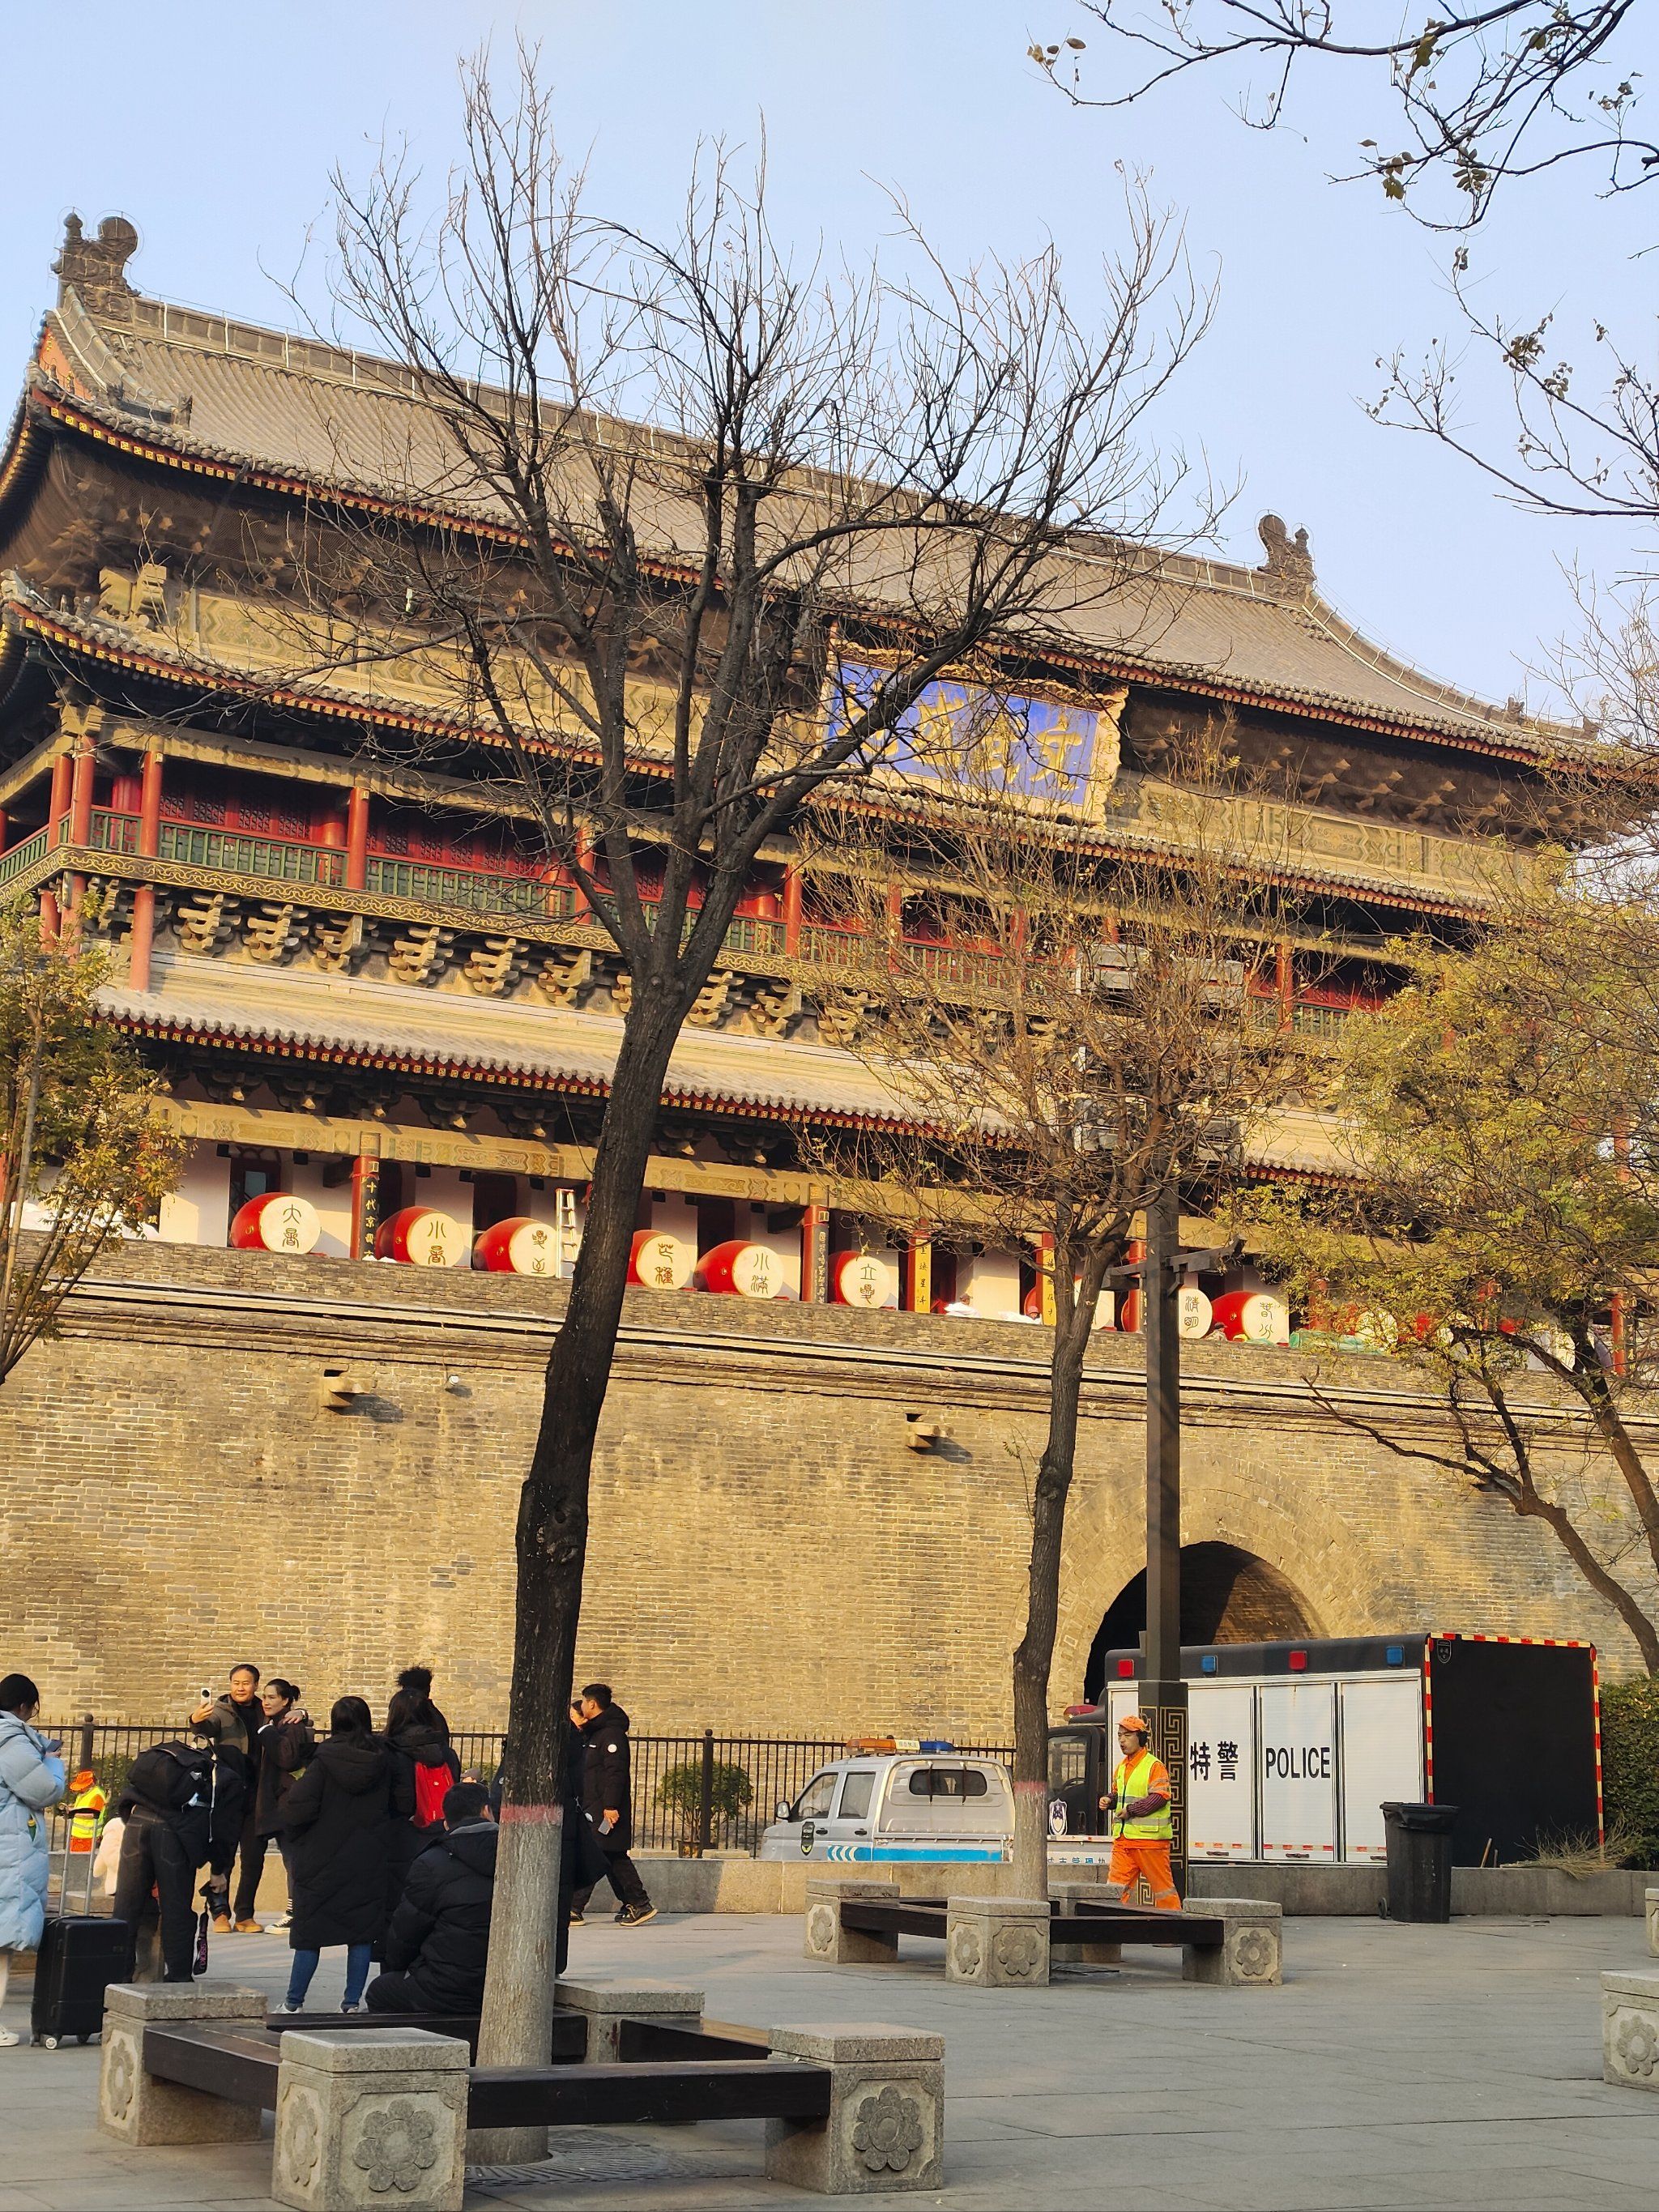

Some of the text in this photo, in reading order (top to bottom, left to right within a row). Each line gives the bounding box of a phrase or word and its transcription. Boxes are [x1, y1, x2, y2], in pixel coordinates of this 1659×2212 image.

[282, 1204, 302, 1248] 大暑
[427, 1220, 446, 1265] 小暑
[1190, 1741, 1239, 1781] 特警
[1265, 1746, 1331, 1779] POLICE
